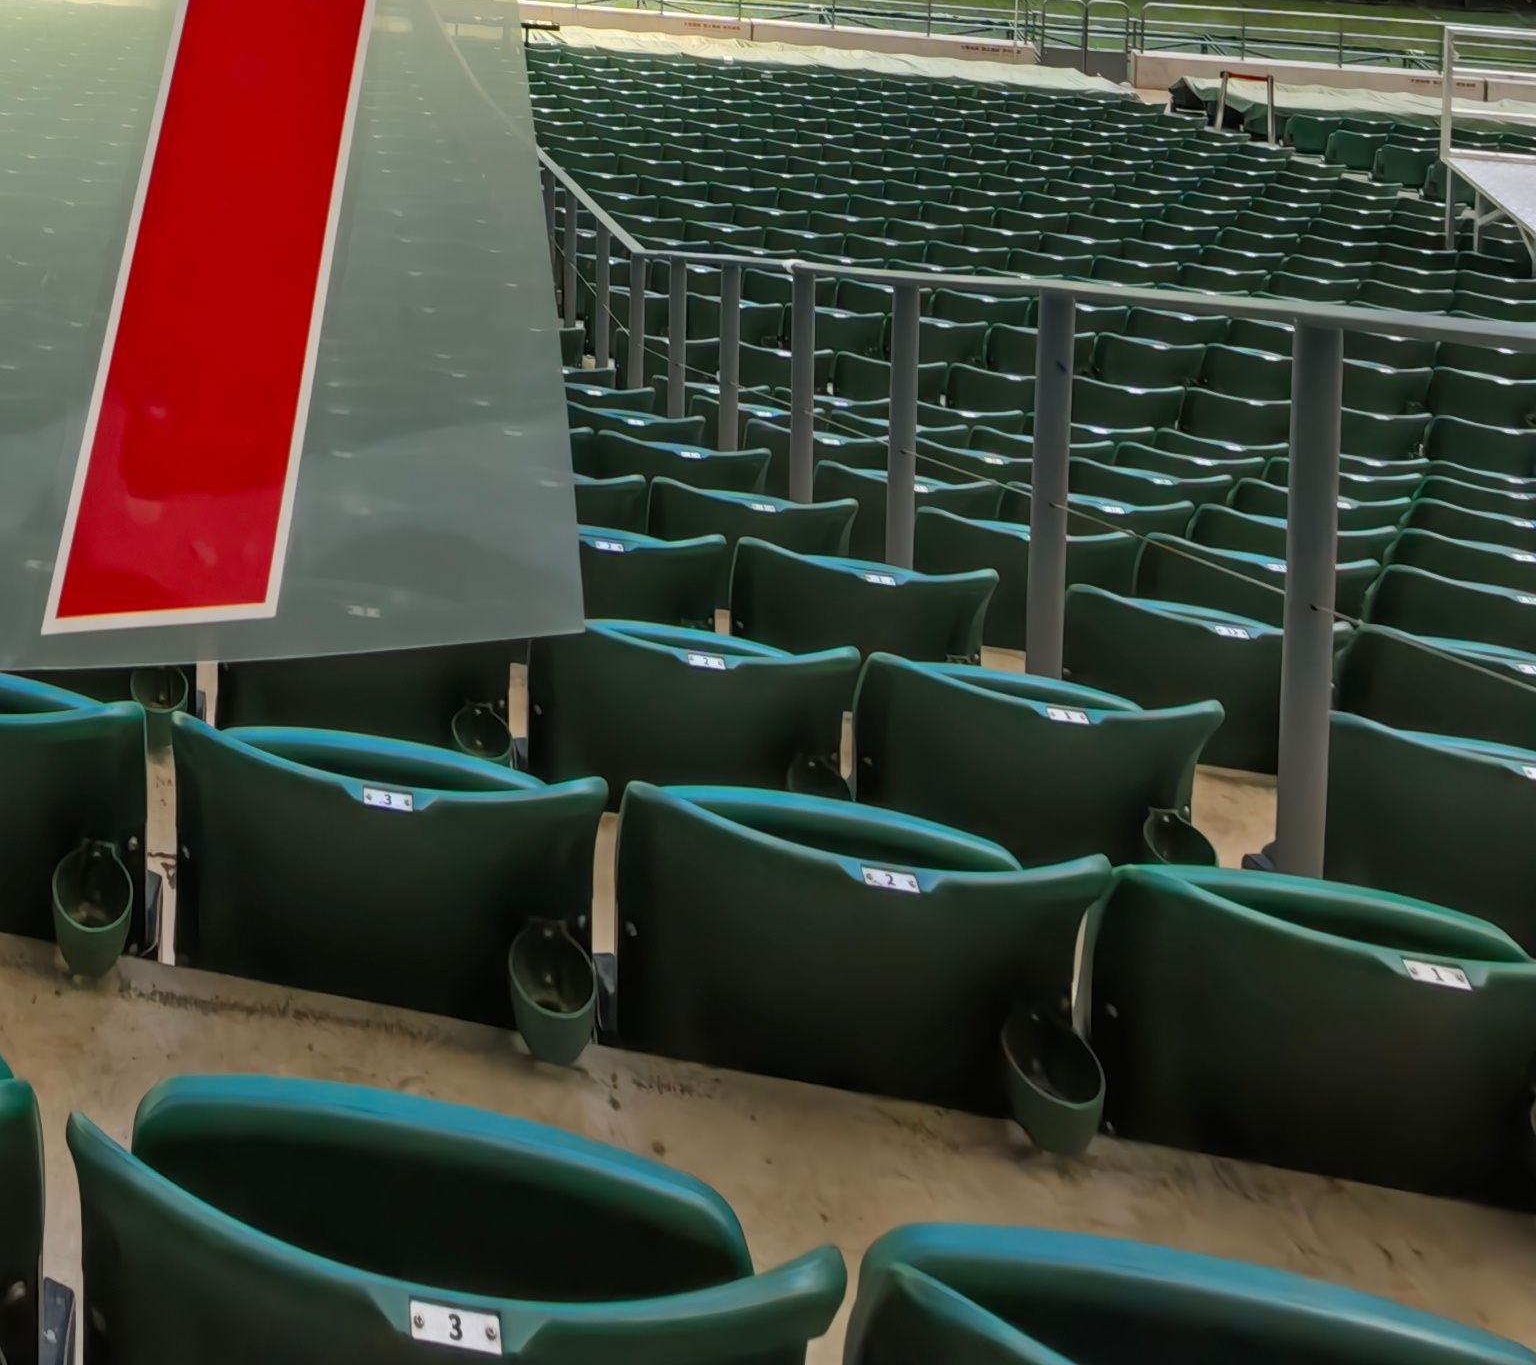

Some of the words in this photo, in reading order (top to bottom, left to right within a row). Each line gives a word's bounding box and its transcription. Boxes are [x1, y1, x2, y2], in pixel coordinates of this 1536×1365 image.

[884, 873, 896, 887] 2
[1430, 967, 1445, 983] 1
[448, 1313, 463, 1341] 3
